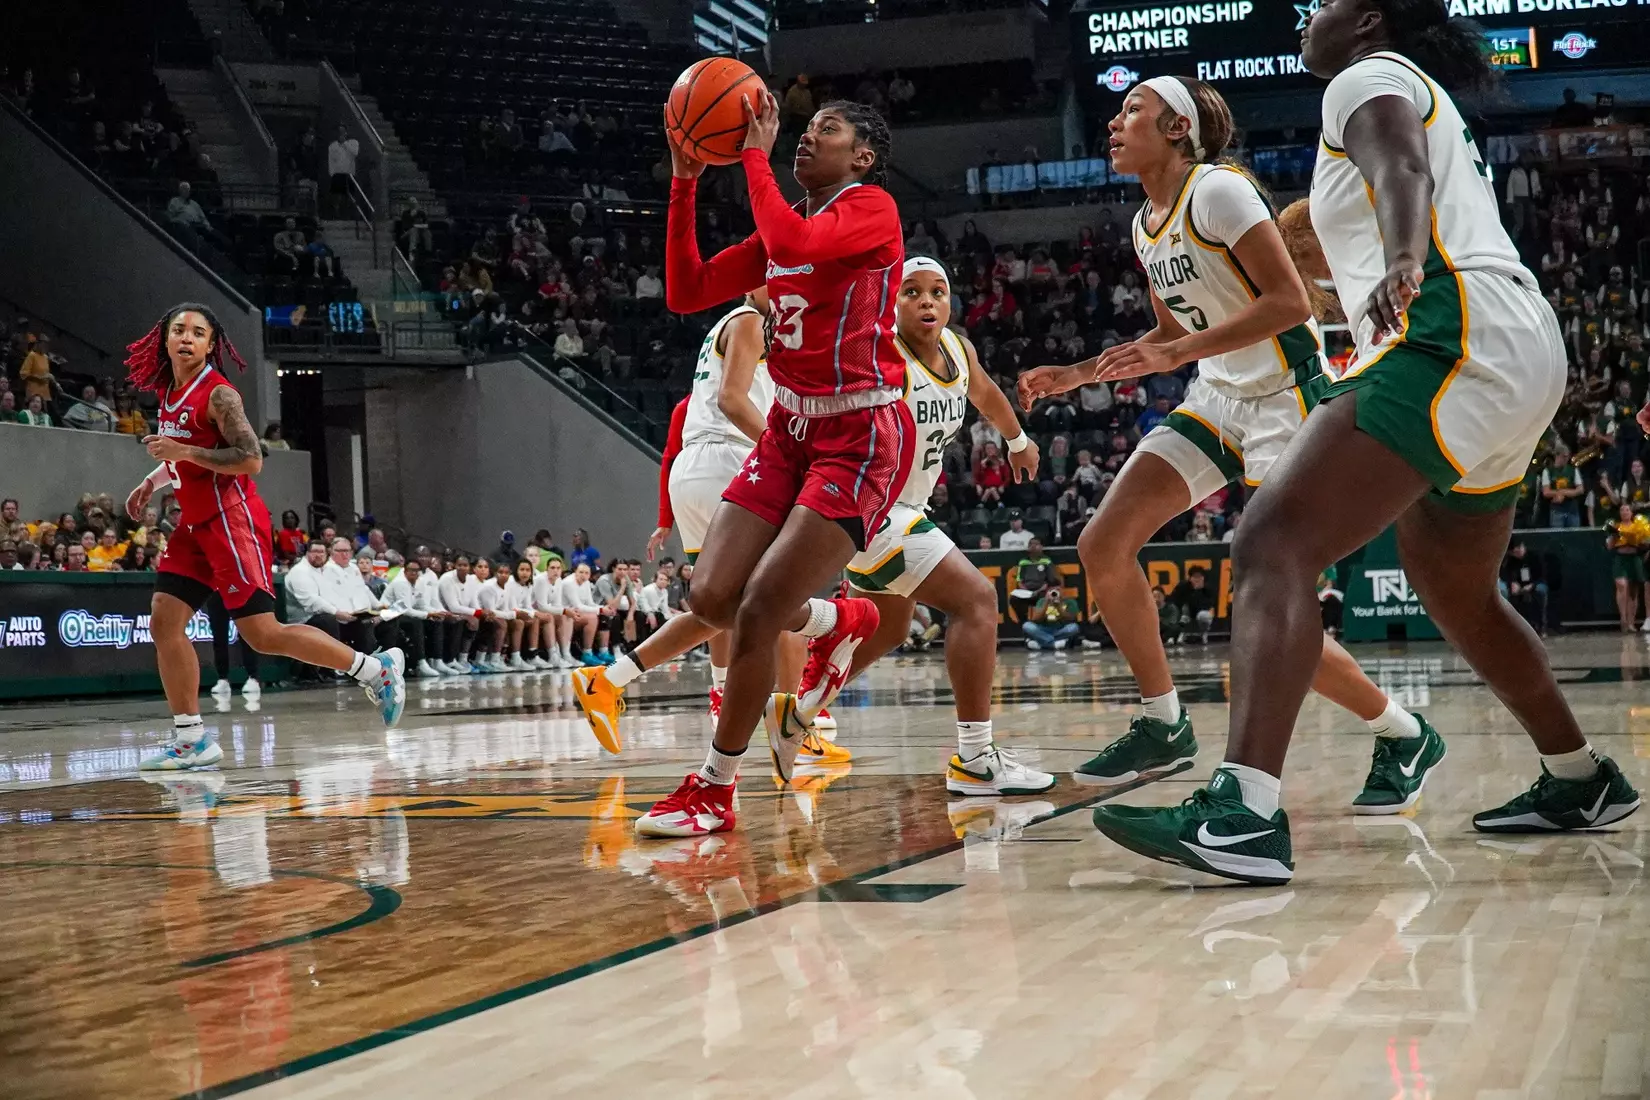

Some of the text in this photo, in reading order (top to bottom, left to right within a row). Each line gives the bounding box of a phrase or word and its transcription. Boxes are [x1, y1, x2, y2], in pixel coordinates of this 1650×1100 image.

[1088, 1, 1253, 33] CHAMPIONSHIP
[1444, 0, 1511, 18] ARM
[1089, 28, 1189, 54] PARTNER
[1491, 37, 1518, 51] 1ST
[1197, 54, 1309, 81] FLAT ROCK TRA
[1148, 253, 1200, 291] AYLOR
[1163, 294, 1209, 332] 5
[916, 396, 967, 424] BAYLO
[1352, 606, 1375, 617] Your
[1376, 604, 1402, 617] Bank
[1403, 603, 1419, 616] for
[9, 616, 42, 632] AUTO
[61, 612, 132, 646] O'Reilly
[6, 632, 46, 647] PARTS
